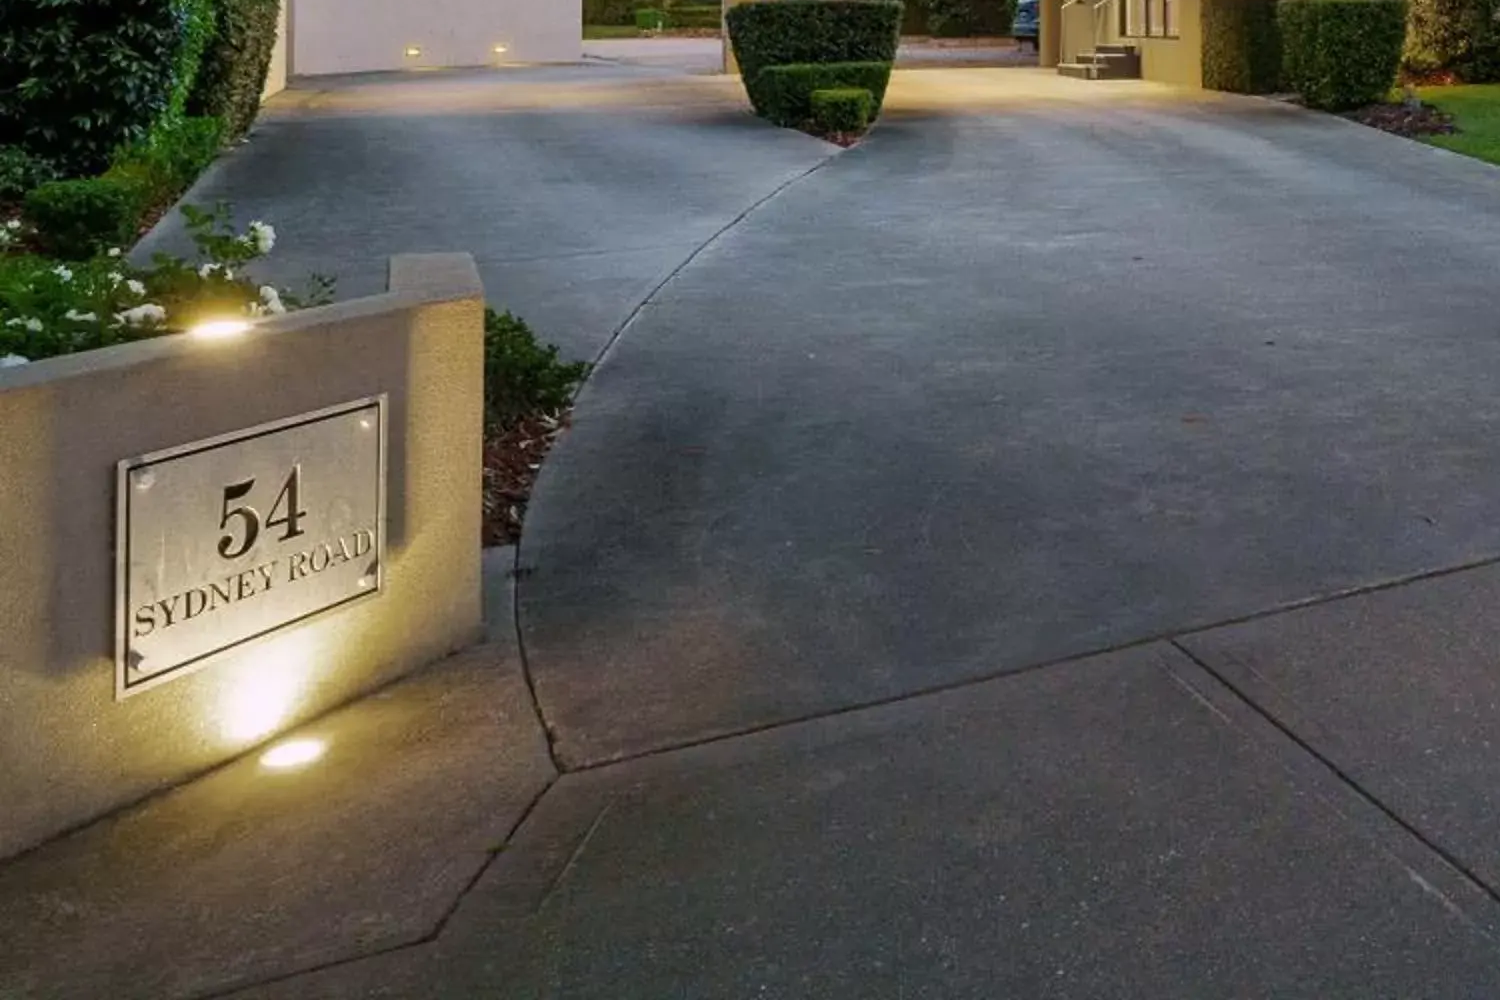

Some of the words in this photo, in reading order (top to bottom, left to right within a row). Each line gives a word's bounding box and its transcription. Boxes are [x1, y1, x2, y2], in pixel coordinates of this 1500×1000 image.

[217, 463, 307, 560] 54
[134, 561, 278, 638] SYDNEY
[286, 530, 374, 583] ROAD
